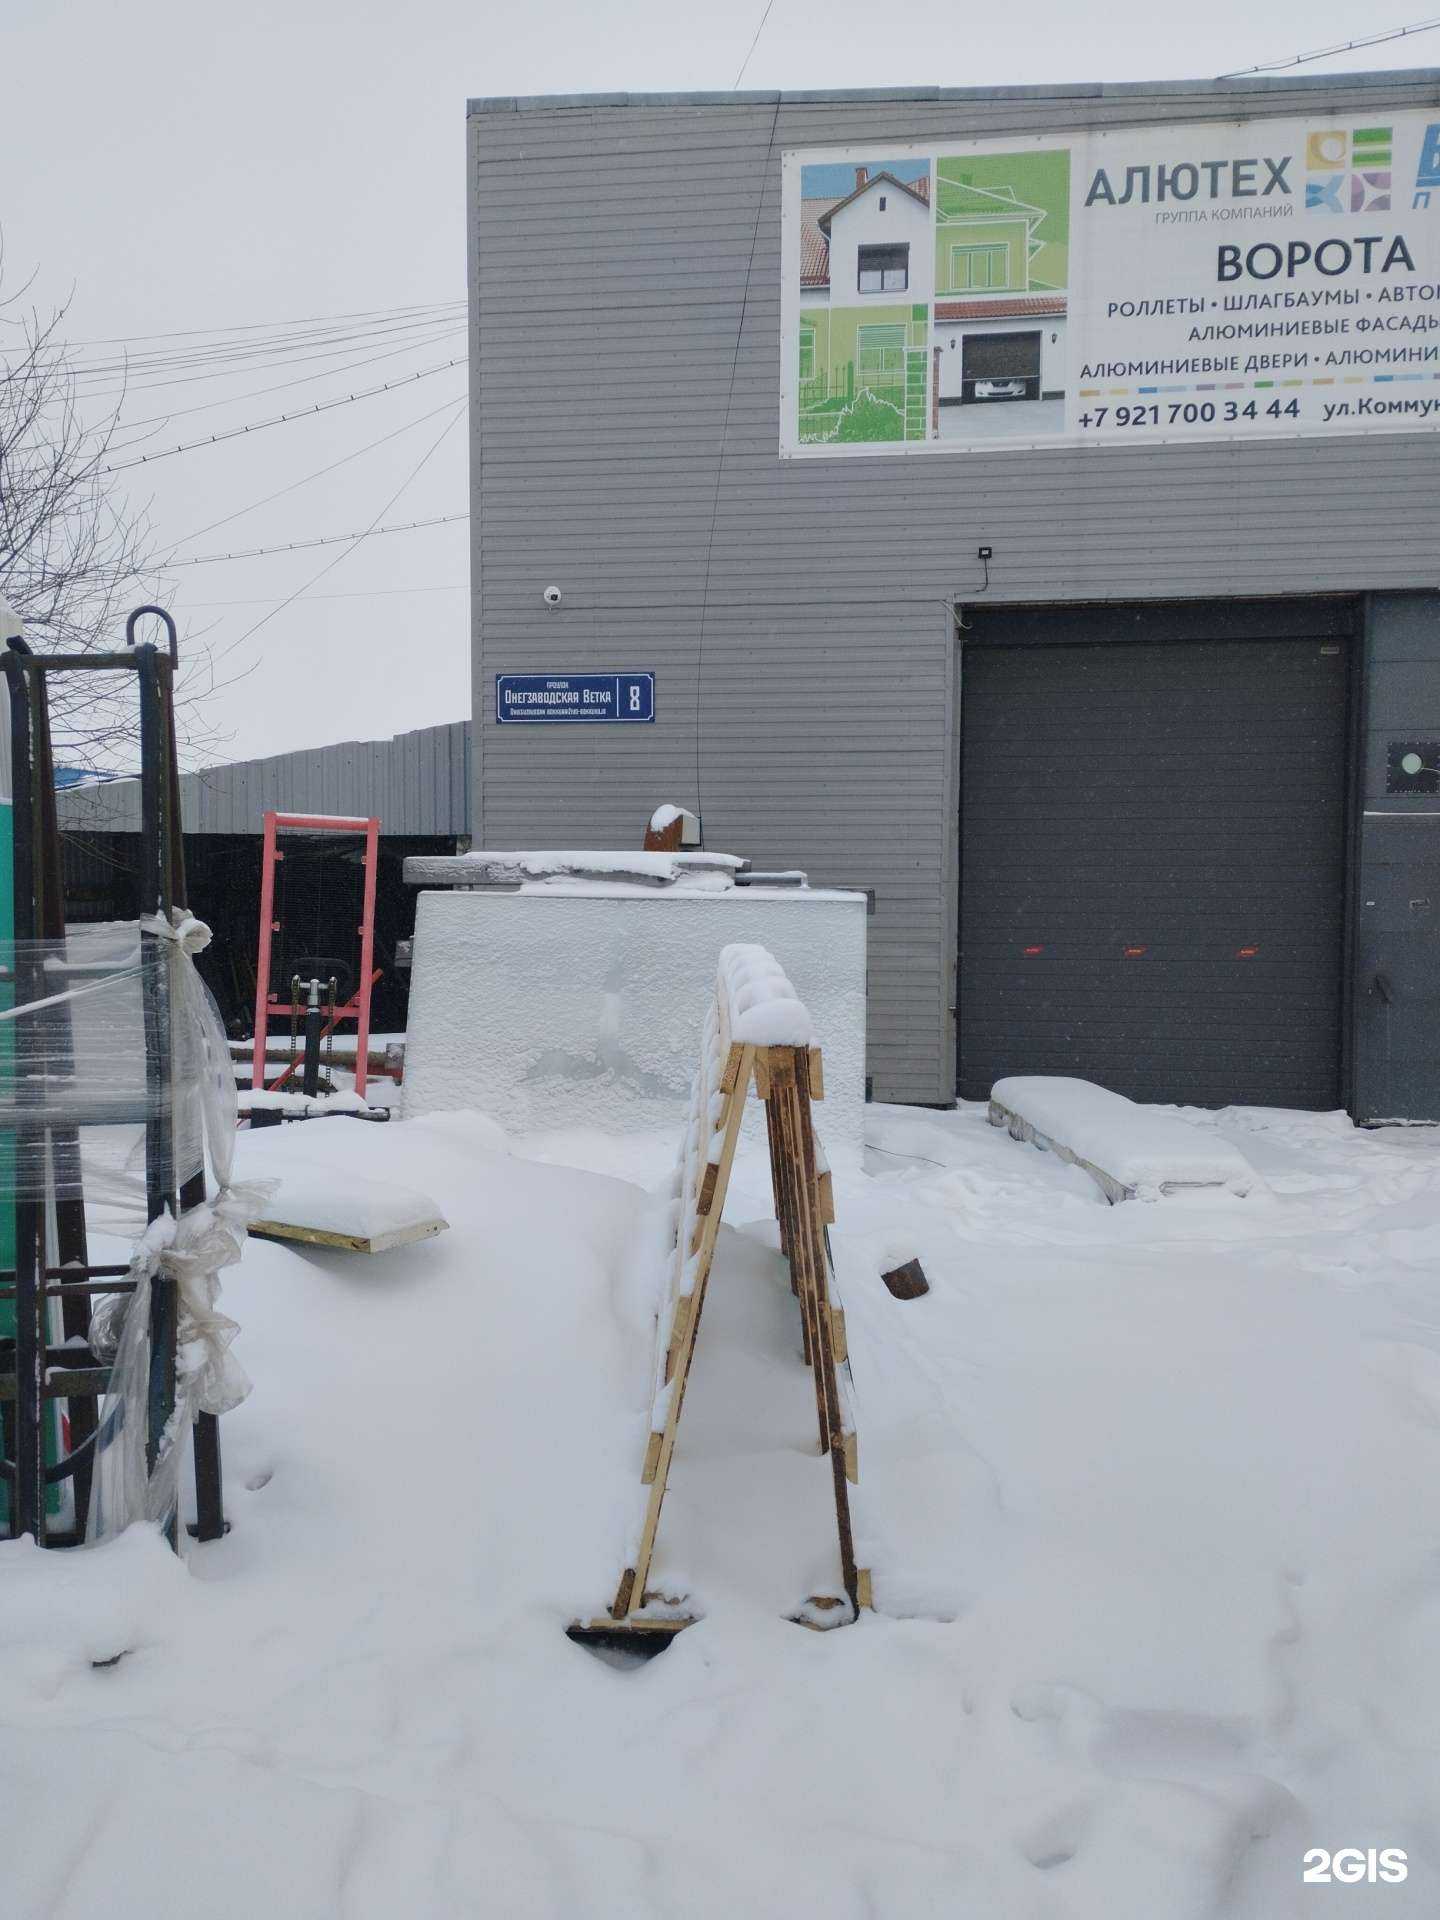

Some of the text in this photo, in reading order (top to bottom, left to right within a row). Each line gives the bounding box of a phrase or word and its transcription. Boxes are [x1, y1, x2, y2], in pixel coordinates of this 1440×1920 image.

[1084, 156, 1293, 207] АЛЮТЕХ
[1155, 204, 1293, 225] ГРУППА КОМПАНИЙ
[1217, 235, 1416, 282] ВОРОТА
[1108, 284, 1440, 318] РОЛЛЕТЫ ШЛАГБАУМЫ АВТО
[1188, 318, 1350, 341] АЛЮМИНИЕВЫЕ
[1080, 345, 1439, 379] АЛЮМИНИЕВЫЕ ДВЕРИ АЛЮМИНИ
[1078, 408, 1108, 429] +7
[1115, 404, 1160, 428] 921
[1168, 402, 1216, 424] 700
[1224, 400, 1258, 422] 34
[1266, 398, 1300, 419] 44
[629, 685, 640, 711] 8
